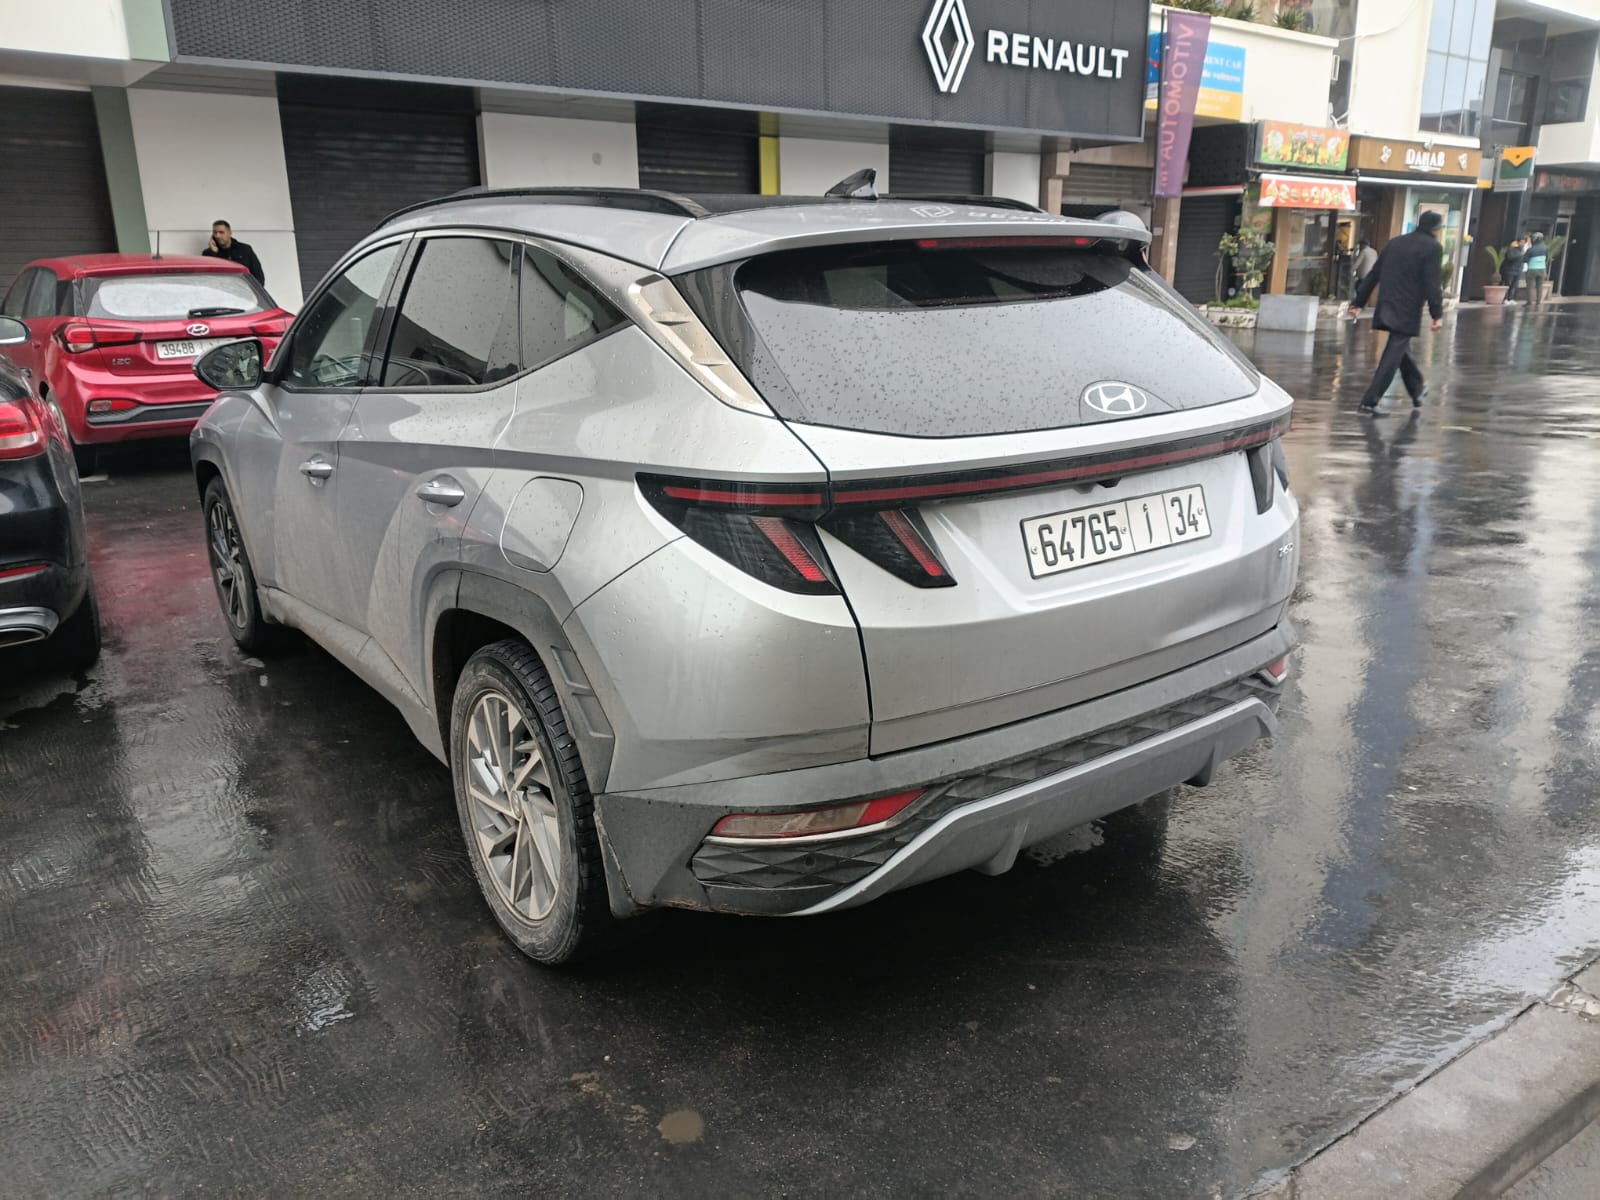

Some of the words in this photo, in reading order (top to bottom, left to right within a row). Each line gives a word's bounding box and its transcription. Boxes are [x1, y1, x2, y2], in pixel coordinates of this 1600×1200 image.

[986, 29, 1129, 79] RENAULT
[162, 341, 195, 356] 39488
[1038, 509, 1122, 567] 64765
[1170, 493, 1199, 536] 34
